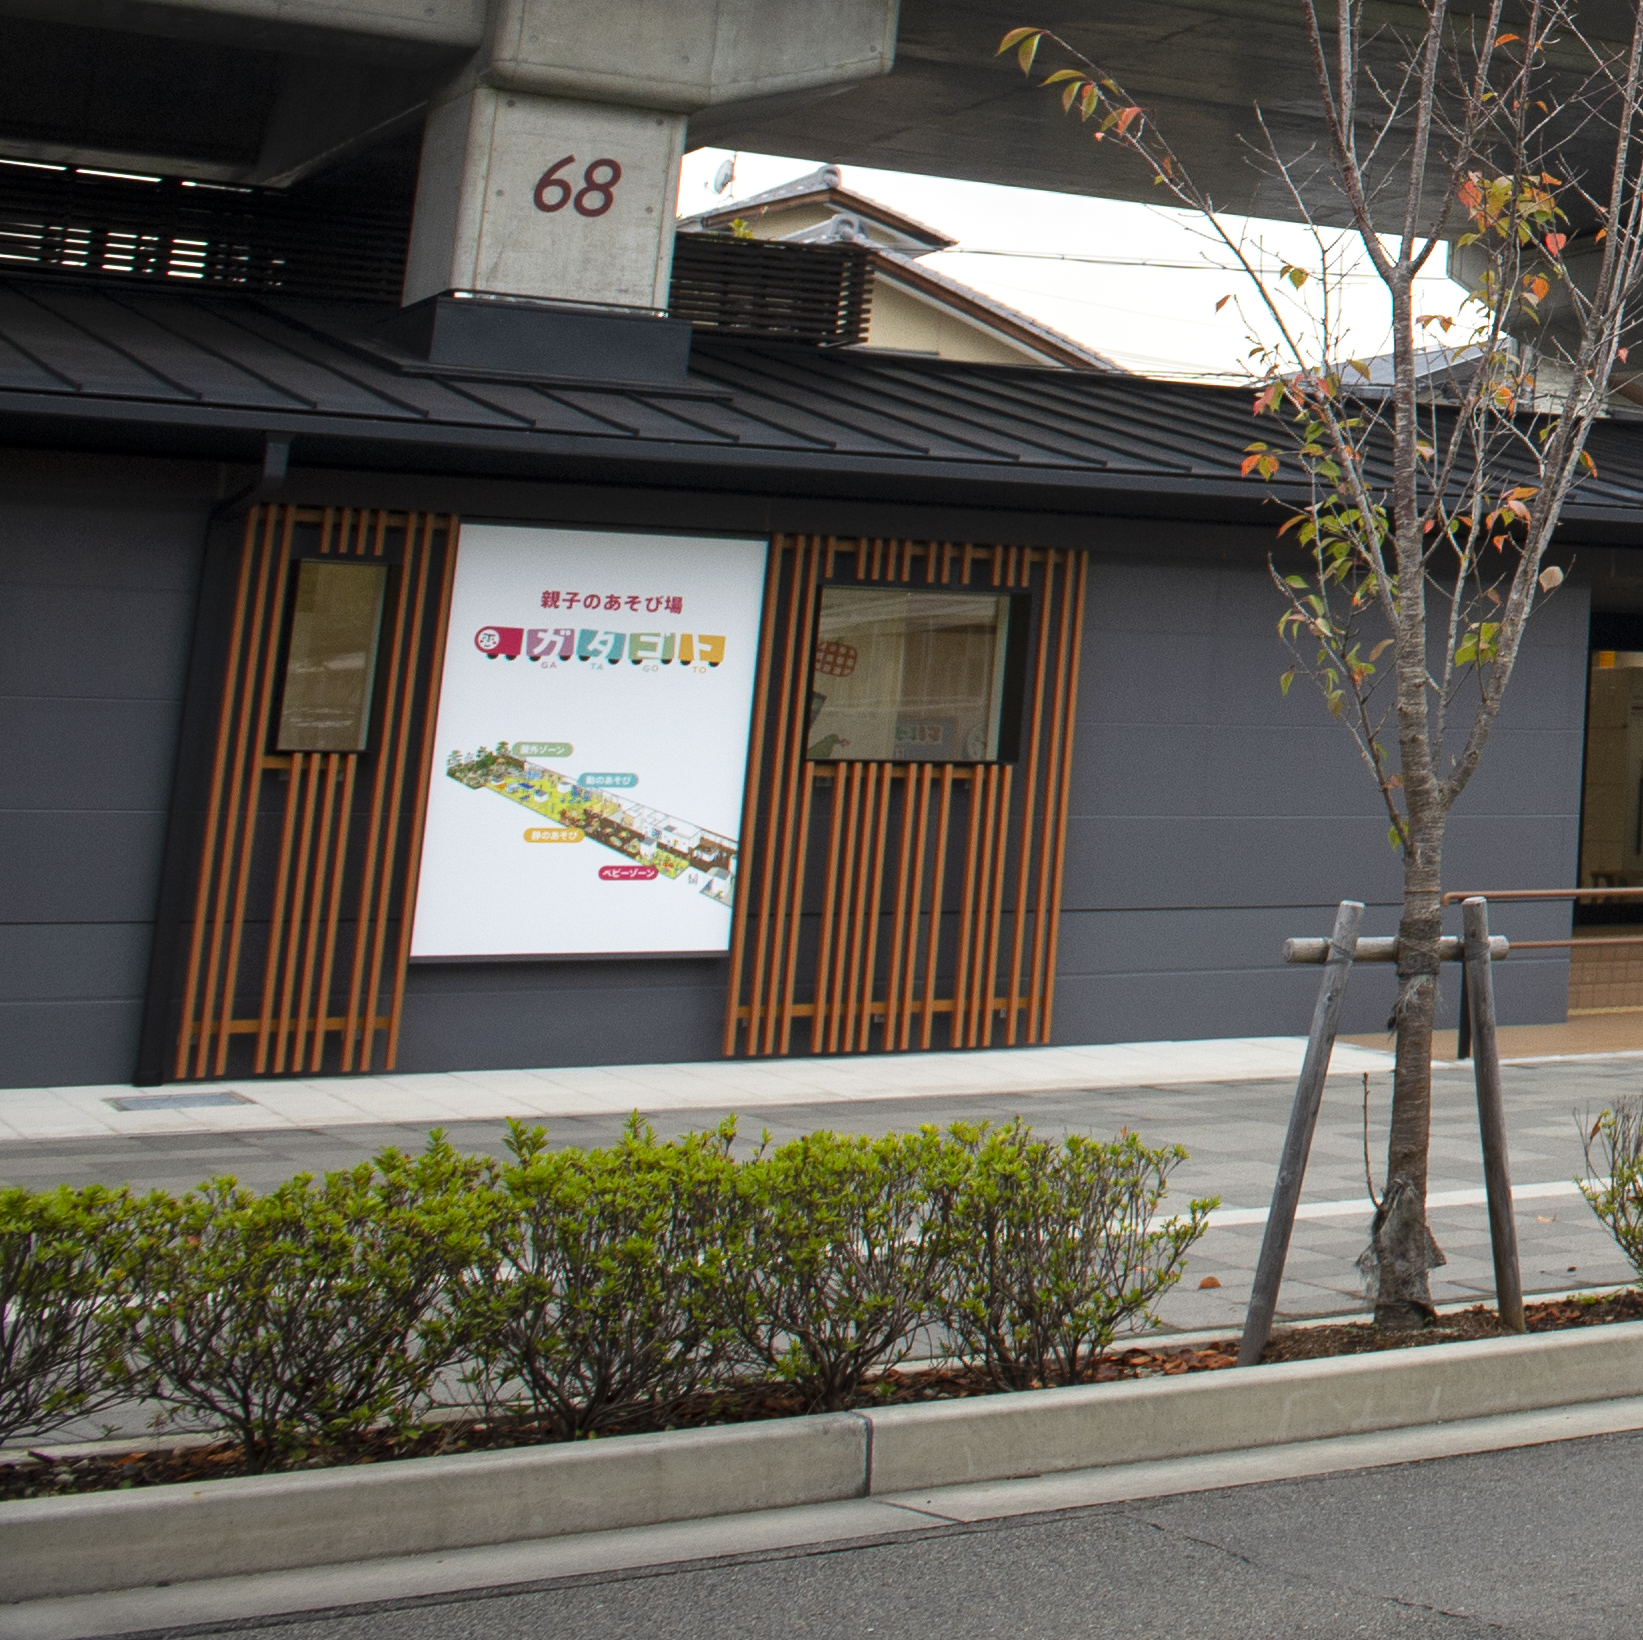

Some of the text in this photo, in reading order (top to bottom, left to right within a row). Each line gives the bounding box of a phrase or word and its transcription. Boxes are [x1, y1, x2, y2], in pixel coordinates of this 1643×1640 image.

[533, 154, 622, 218] 68
[540, 590, 683, 614] 親子のあそび場
[540, 661, 557, 669] GA
[642, 665, 659, 673] GO
[692, 666, 707, 674] TO
[603, 867, 655, 878] ベビーゾーン
